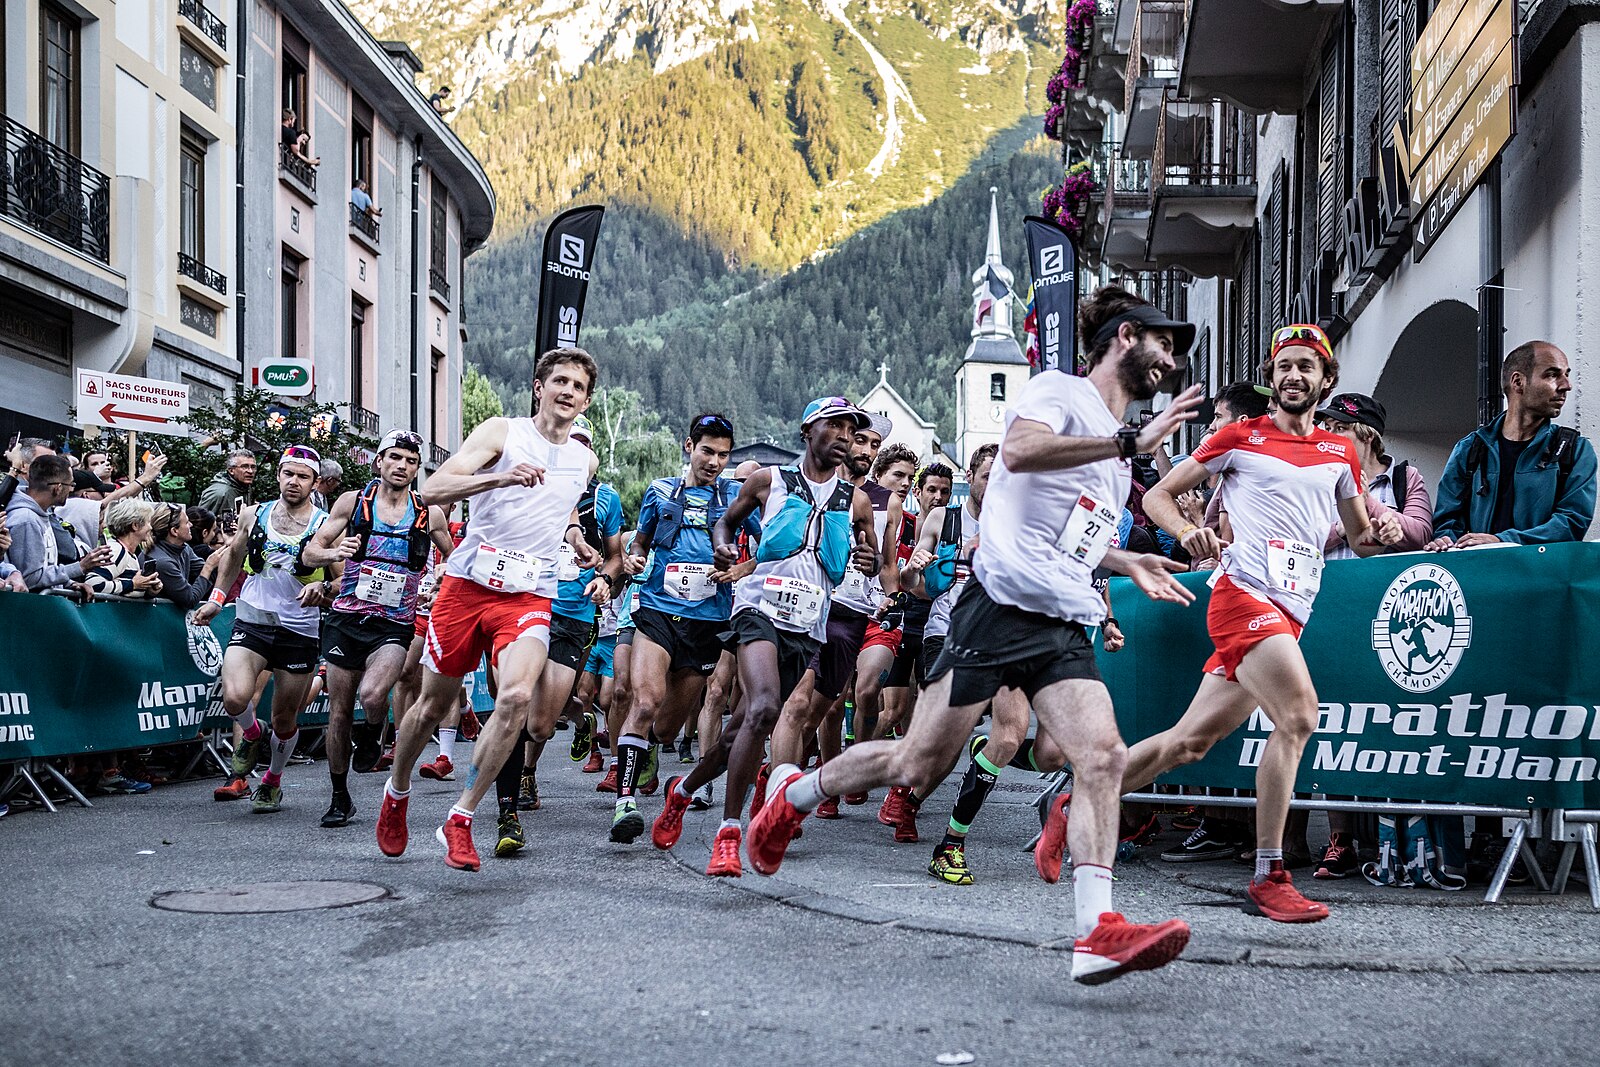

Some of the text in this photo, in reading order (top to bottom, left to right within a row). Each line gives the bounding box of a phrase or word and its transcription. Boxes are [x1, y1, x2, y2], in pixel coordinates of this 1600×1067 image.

[1434, 84, 1463, 136] Espace
[1465, 38, 1496, 91] Tairraz
[1434, 71, 1509, 184] Musée des Cristaux
[1439, 137, 1489, 223] Saint Michel
[547, 261, 590, 281] salomo
[267, 372, 289, 381] PMU
[105, 380, 186, 398] SACS COUREURS
[112, 391, 180, 407] RUNNERS BAG
[1084, 520, 1101, 538] 27
[503, 549, 525, 559] 42km
[1292, 543, 1311, 553] 42km
[496, 560, 506, 571] 5
[1287, 557, 1295, 571] 9
[370, 580, 383, 590] 33
[681, 576, 689, 585] 6
[777, 591, 799, 605] 115
[1383, 568, 1464, 613] MONT BLANC
[1392, 587, 1451, 623] MARATHON
[1386, 660, 1453, 689] CHAMONIX
[138, 712, 170, 732] Du
[1248, 693, 1600, 741] aratho
[1238, 738, 1600, 783] D Mont-Blan
